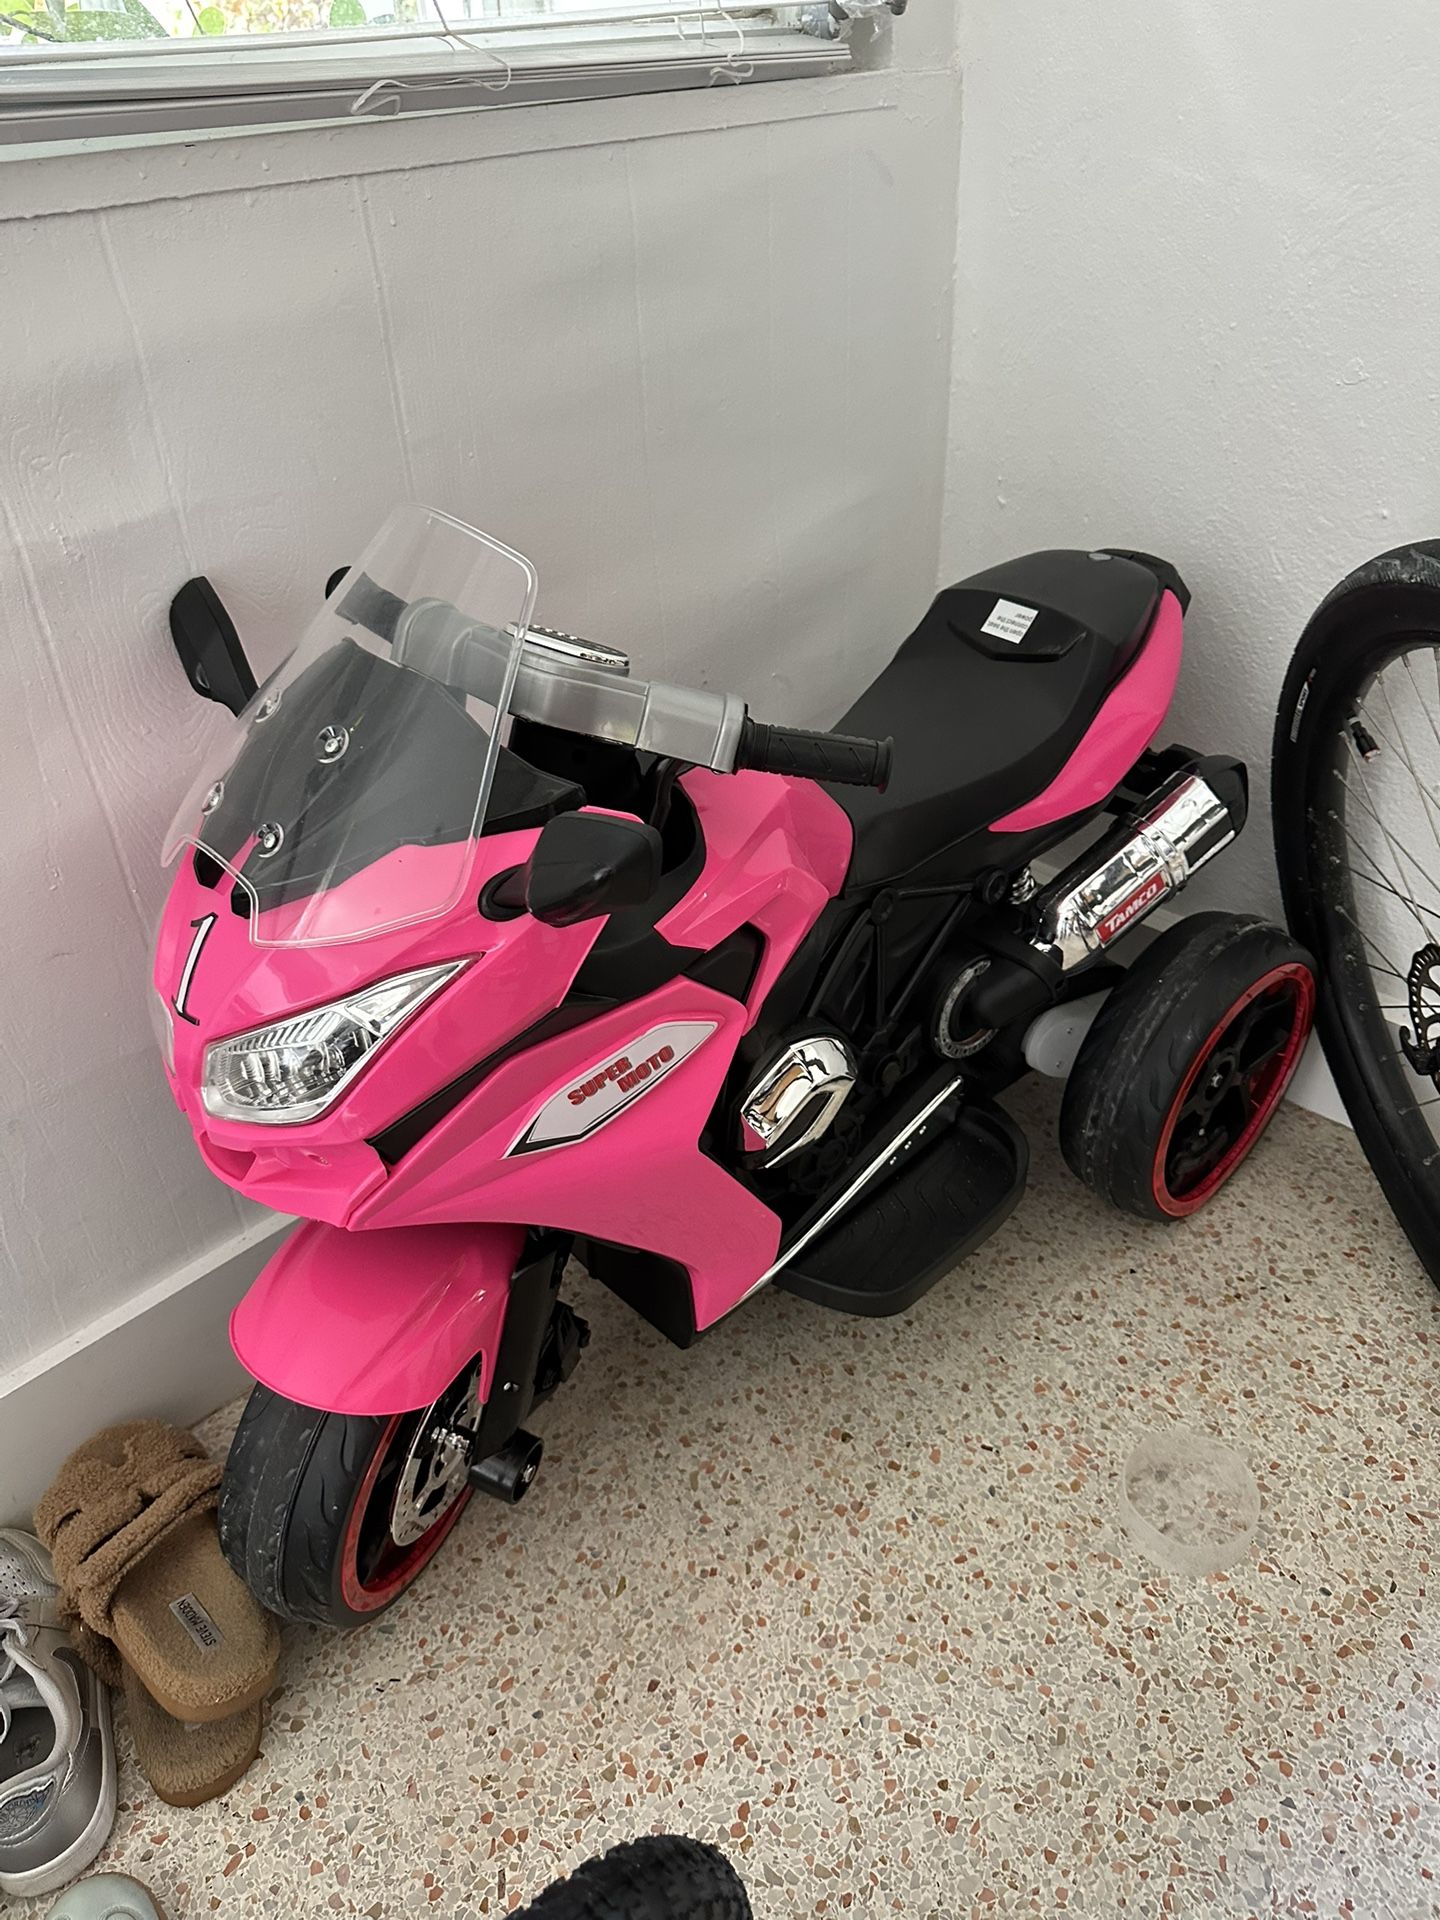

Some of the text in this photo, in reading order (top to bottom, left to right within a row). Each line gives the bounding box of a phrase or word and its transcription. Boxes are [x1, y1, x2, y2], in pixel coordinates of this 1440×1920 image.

[1105, 883, 1157, 932] TAMCO
[171, 911, 219, 1026] 1
[567, 1056, 633, 1106] SUPER
[616, 1044, 675, 1093] MOTO
[176, 1598, 217, 1647] STEVE MADDEN
